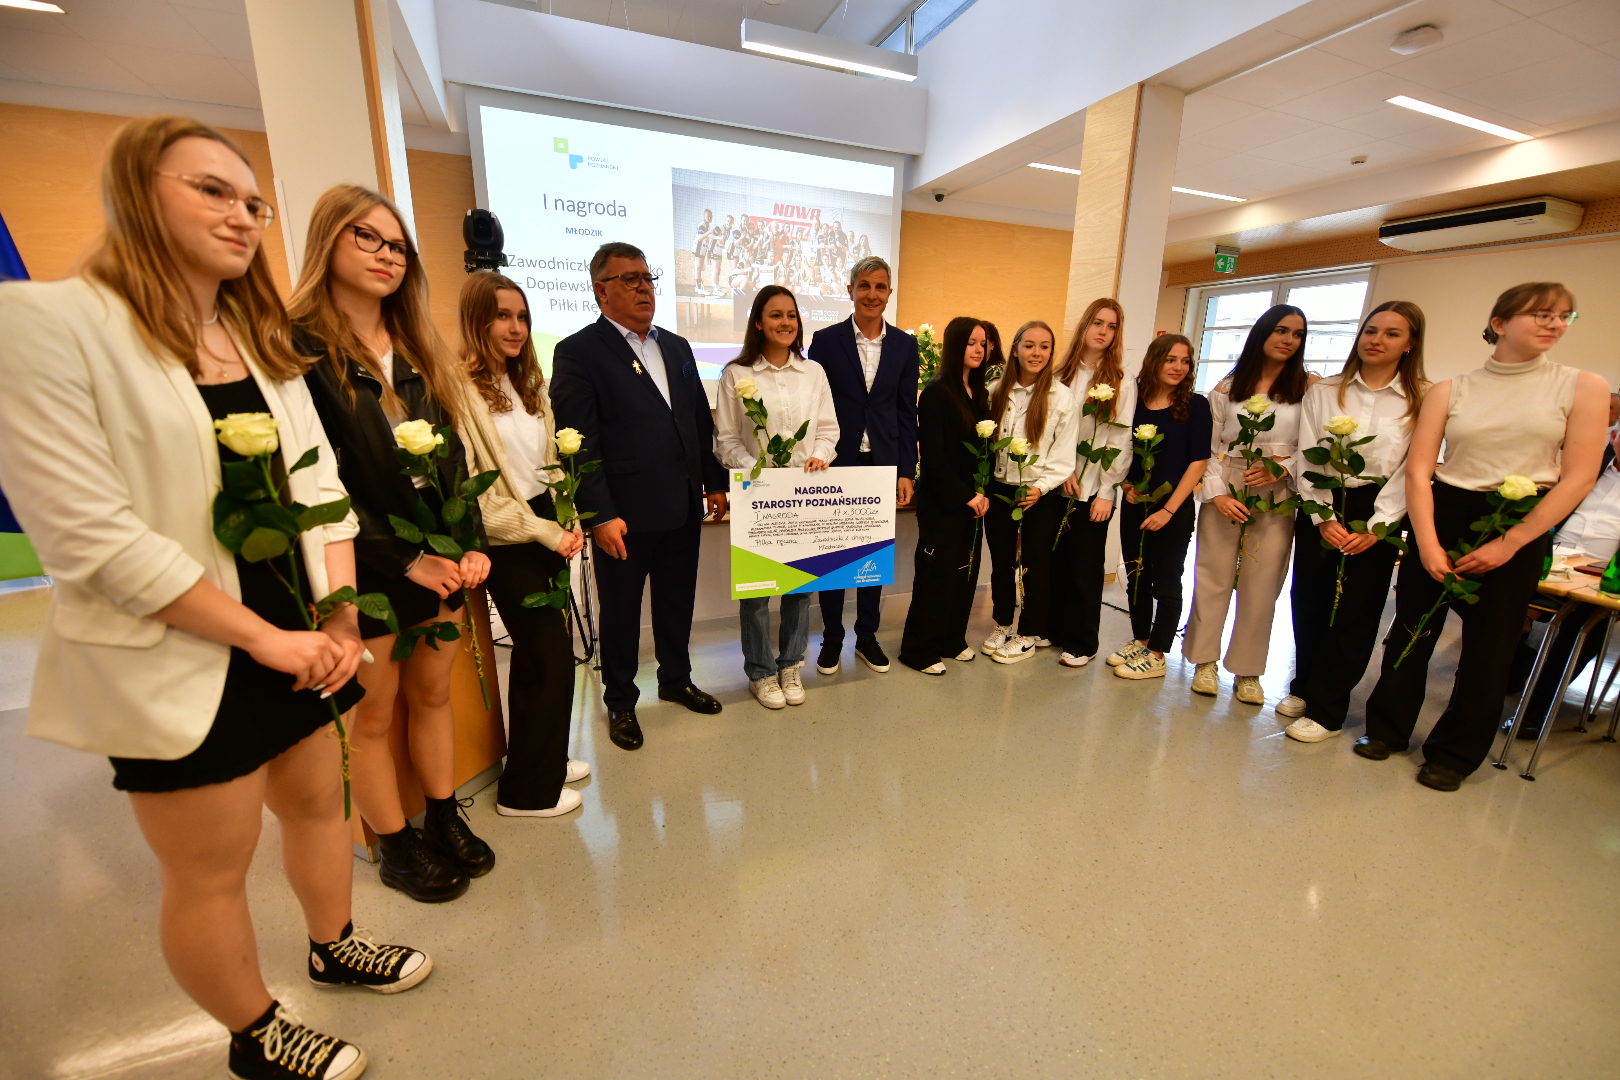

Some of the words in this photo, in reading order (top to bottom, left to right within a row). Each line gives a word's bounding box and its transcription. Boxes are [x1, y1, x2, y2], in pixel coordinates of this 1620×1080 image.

[543, 193, 547, 210] I
[554, 198, 627, 218] nagroda
[772, 202, 822, 220] NOWA
[565, 227, 603, 237] MŁODZIK
[508, 254, 591, 272] Zawodniczk
[526, 276, 594, 293] Dopiewsk
[550, 298, 578, 312] Piłki
[794, 486, 843, 495] NAGRODA
[752, 499, 803, 510] STAROSTY
[806, 496, 881, 508] POZNAŃSKIEGO
[833, 508, 841, 516] 17
